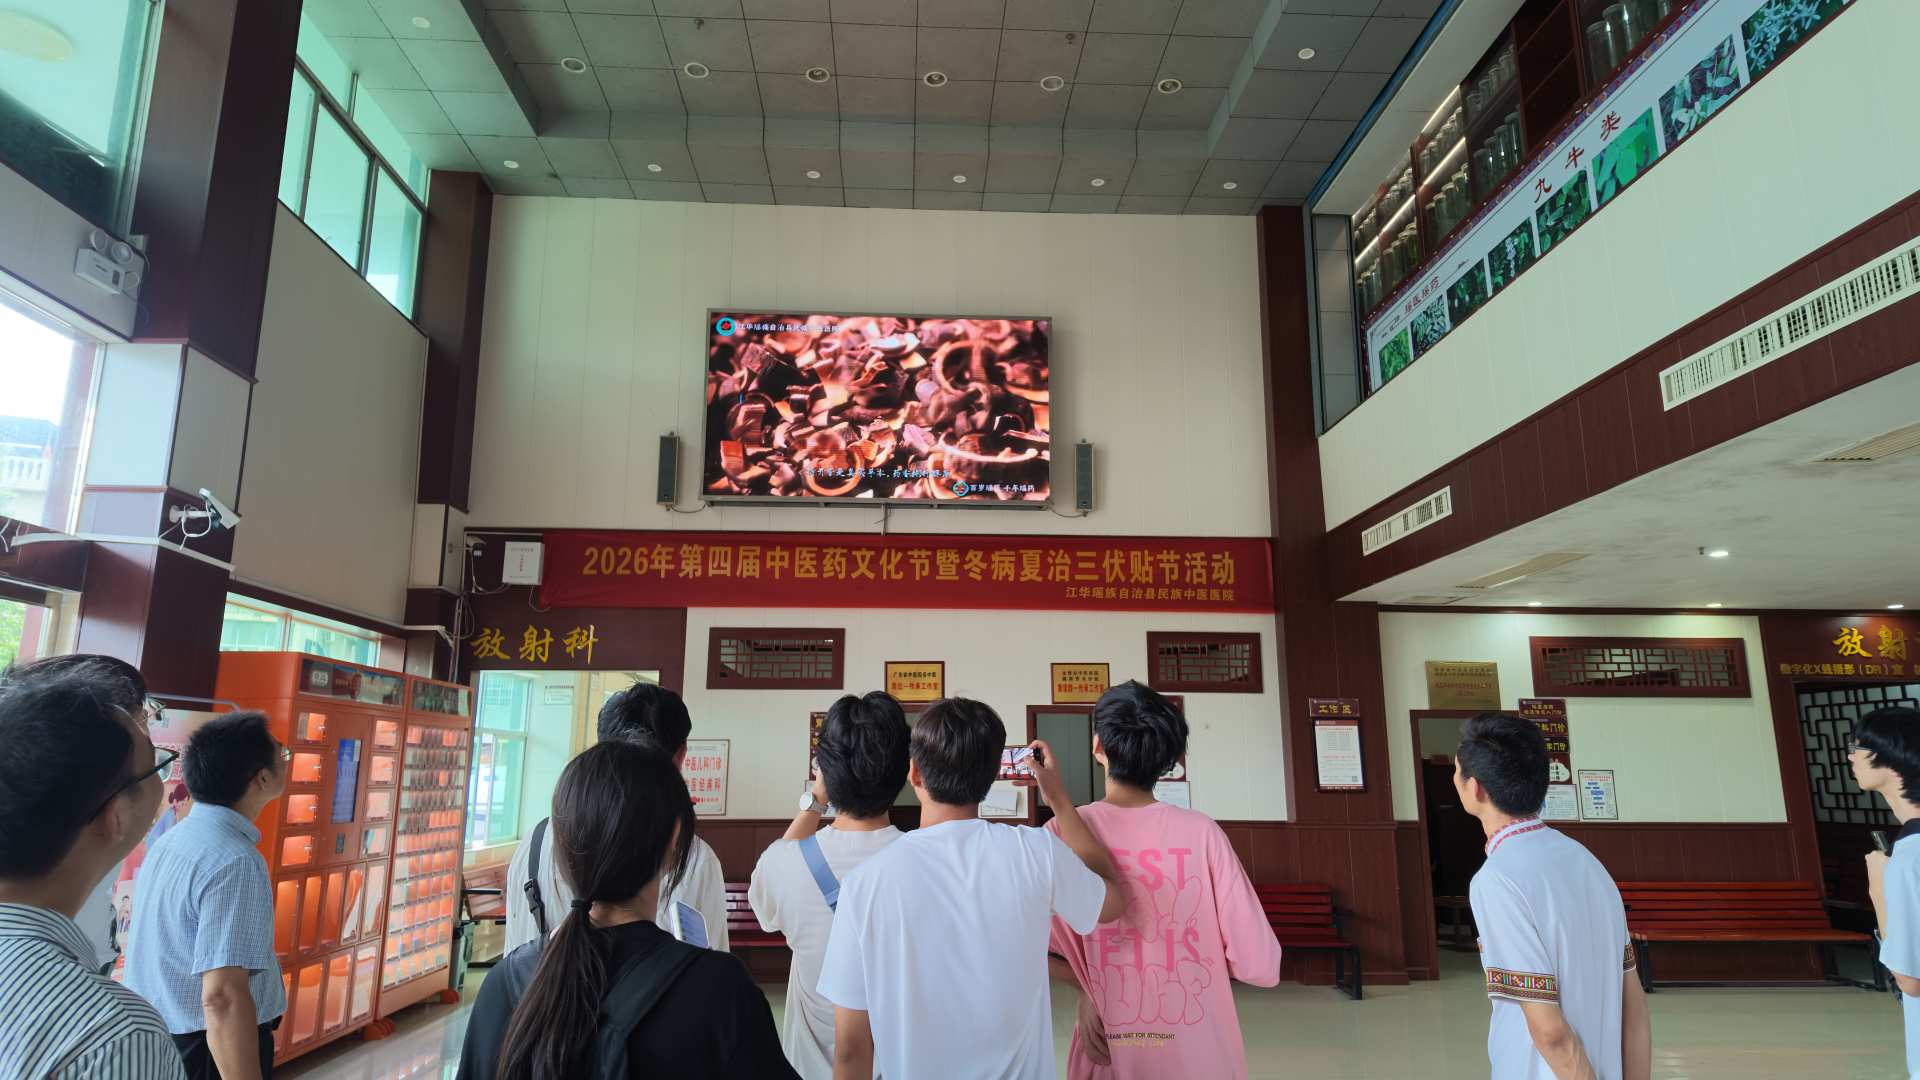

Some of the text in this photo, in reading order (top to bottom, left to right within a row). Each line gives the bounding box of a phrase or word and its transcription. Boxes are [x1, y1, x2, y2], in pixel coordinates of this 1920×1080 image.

[582, 544, 1235, 585] 2026年第四届中医药文化节暨冬病夏治三伏贴节活动
[1065, 586, 1235, 600] 江华瑶族自治县民族中医医院
[470, 624, 599, 664] 放射科
[1832, 624, 1920, 662] 放射
